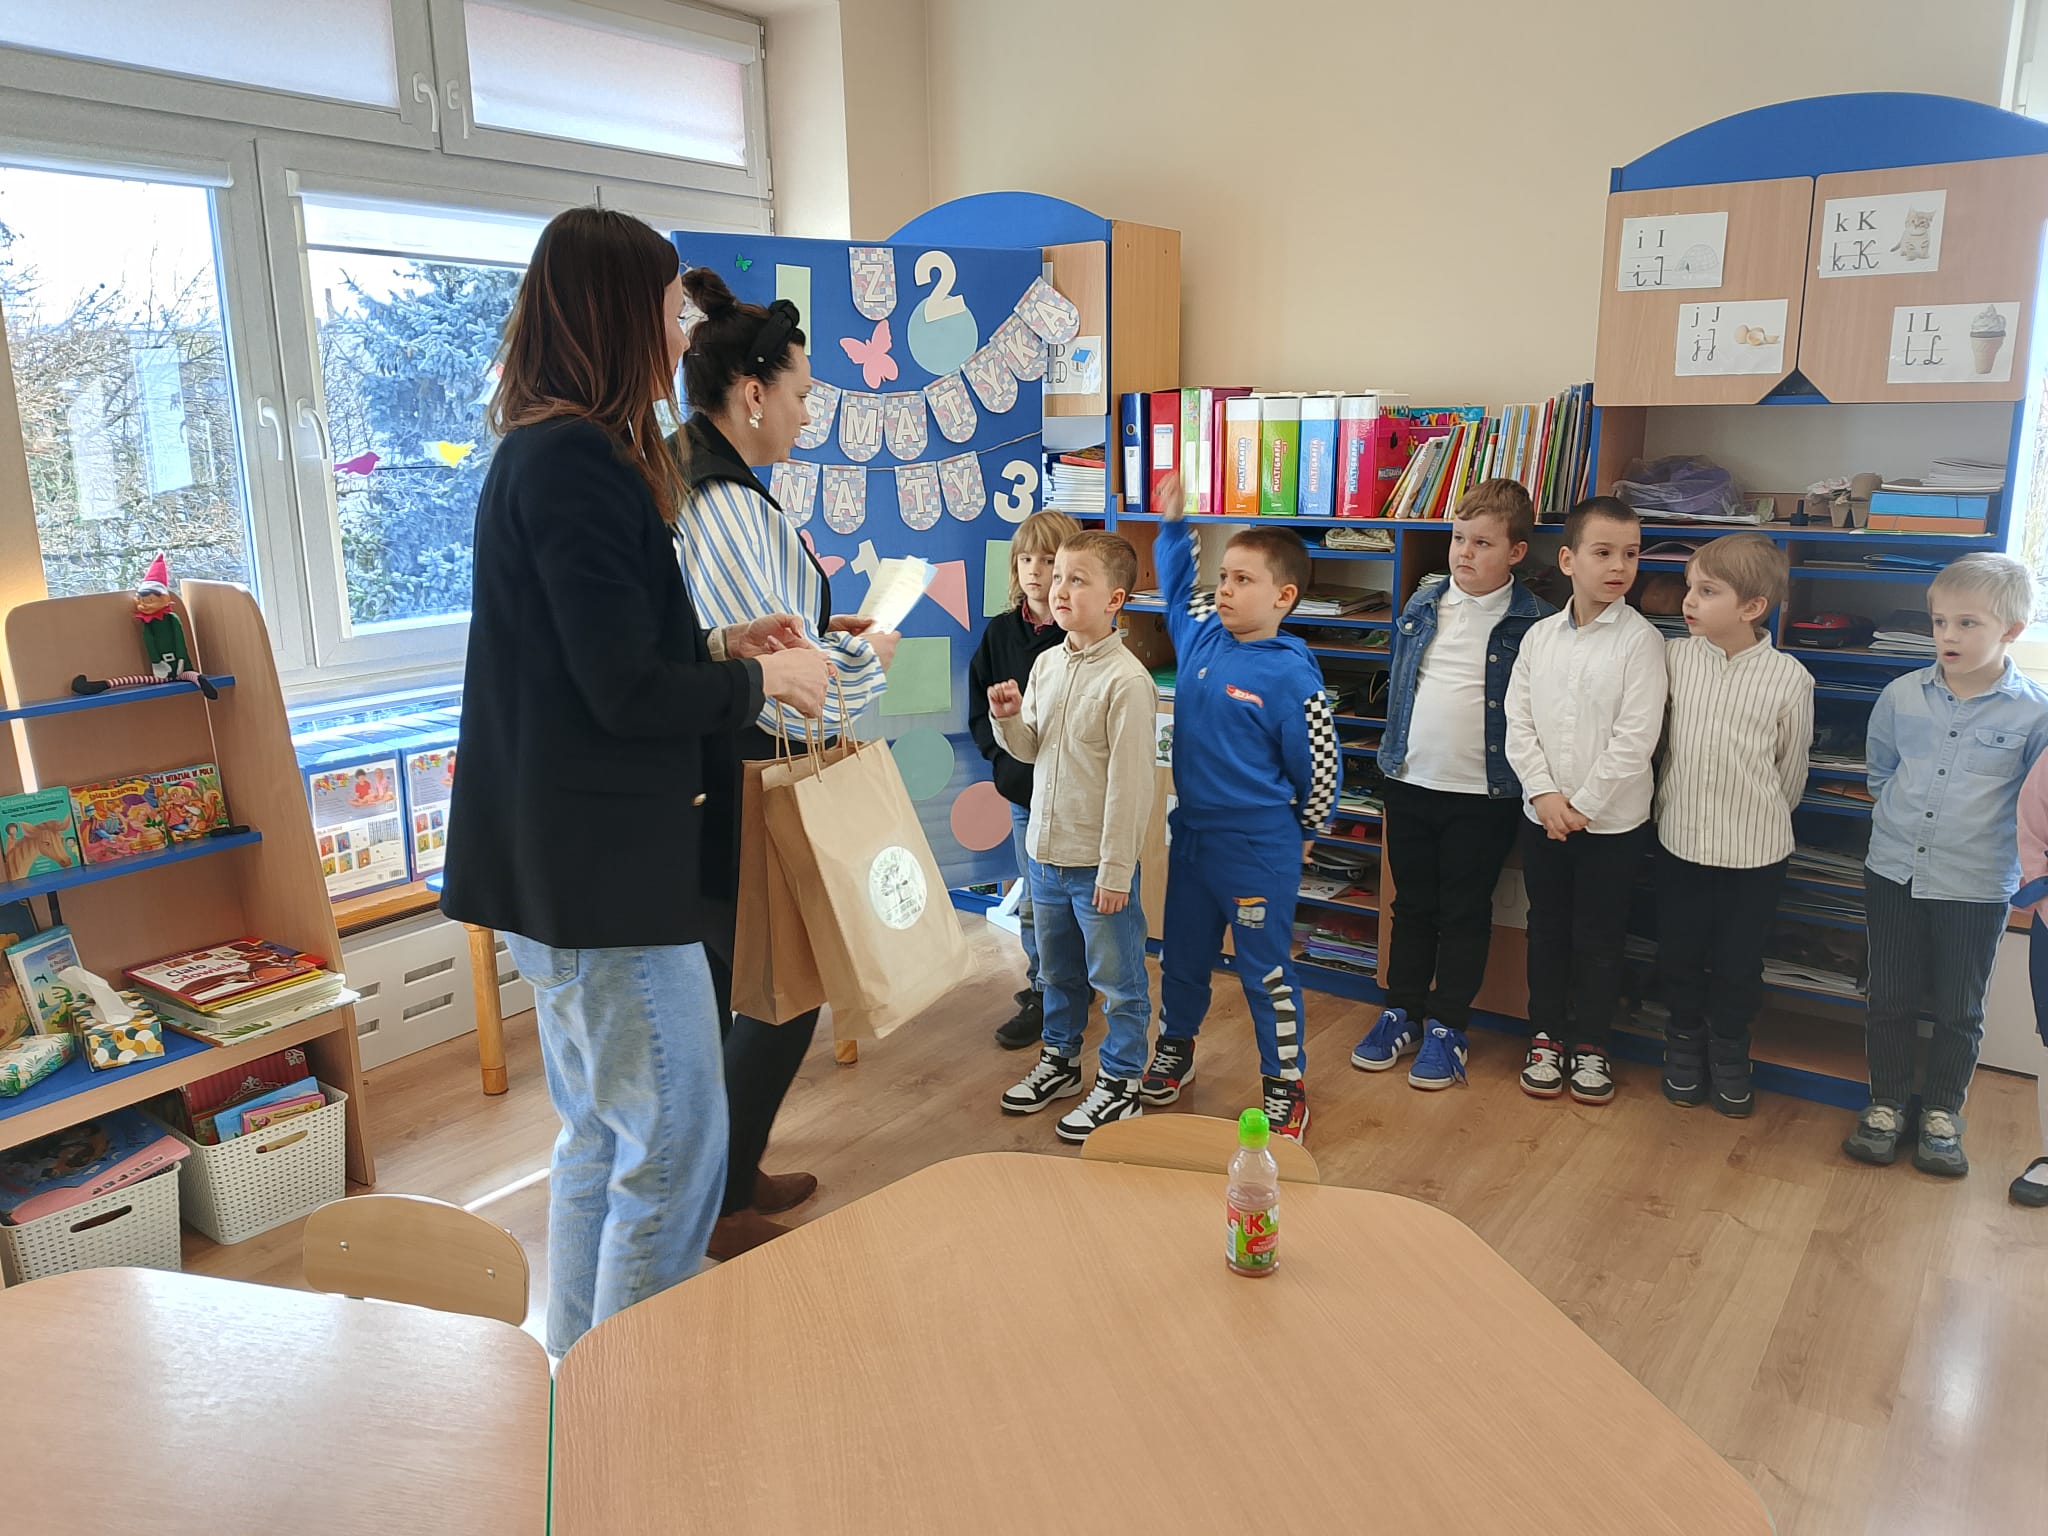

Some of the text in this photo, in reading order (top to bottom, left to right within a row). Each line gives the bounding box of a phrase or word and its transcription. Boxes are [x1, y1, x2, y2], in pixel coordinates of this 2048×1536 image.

[1834, 210, 1877, 233] k K
[860, 263, 887, 303] Z
[914, 250, 967, 324] 2
[1922, 312, 1941, 333] L
[906, 469, 971, 515] TY
[993, 460, 1039, 524] 3
[166, 963, 207, 978] Ciało
[170, 960, 246, 985] człowieka
